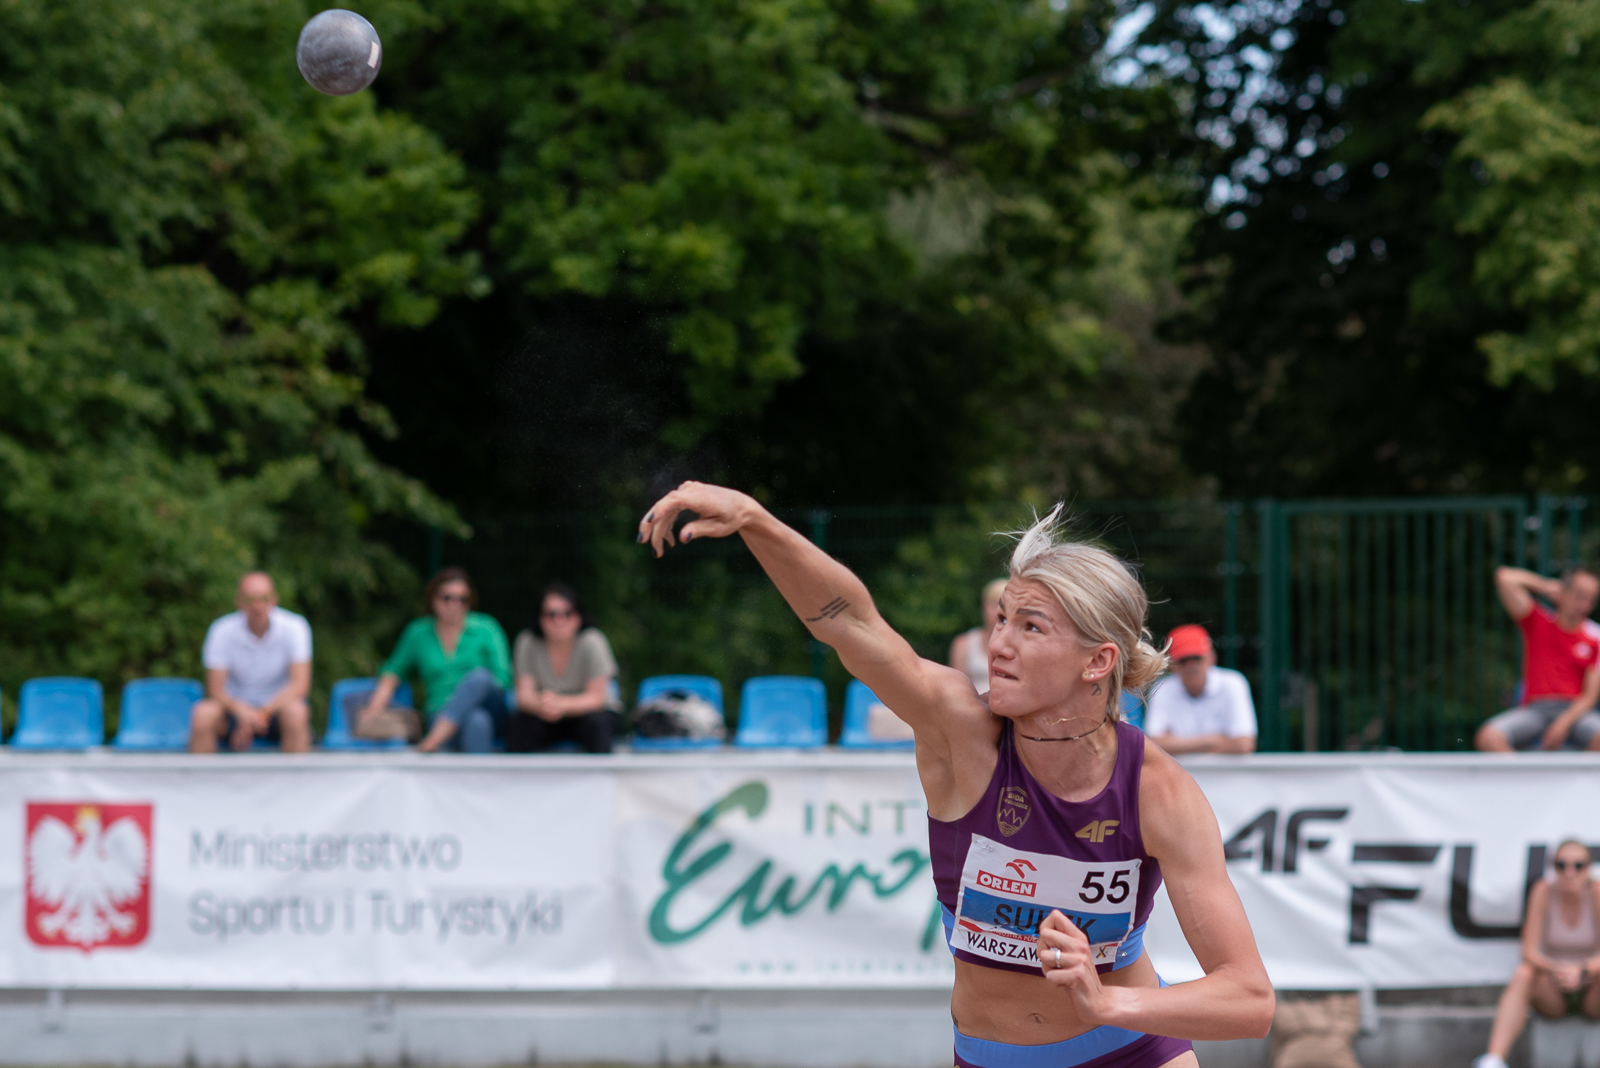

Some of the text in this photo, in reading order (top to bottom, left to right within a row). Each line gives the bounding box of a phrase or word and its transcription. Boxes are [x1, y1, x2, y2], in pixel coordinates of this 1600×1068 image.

[189, 829, 462, 872] Ministerstwo
[1074, 819, 1121, 843] 4F
[1223, 807, 1351, 873] 4F
[979, 873, 1033, 895] ORLEN
[1078, 869, 1131, 904] 55
[1349, 843, 1600, 943] FU
[187, 891, 333, 942] Sportu
[369, 891, 564, 943] Turystyki
[993, 903, 1097, 944] SUK
[966, 931, 1042, 962] WARSZAW
